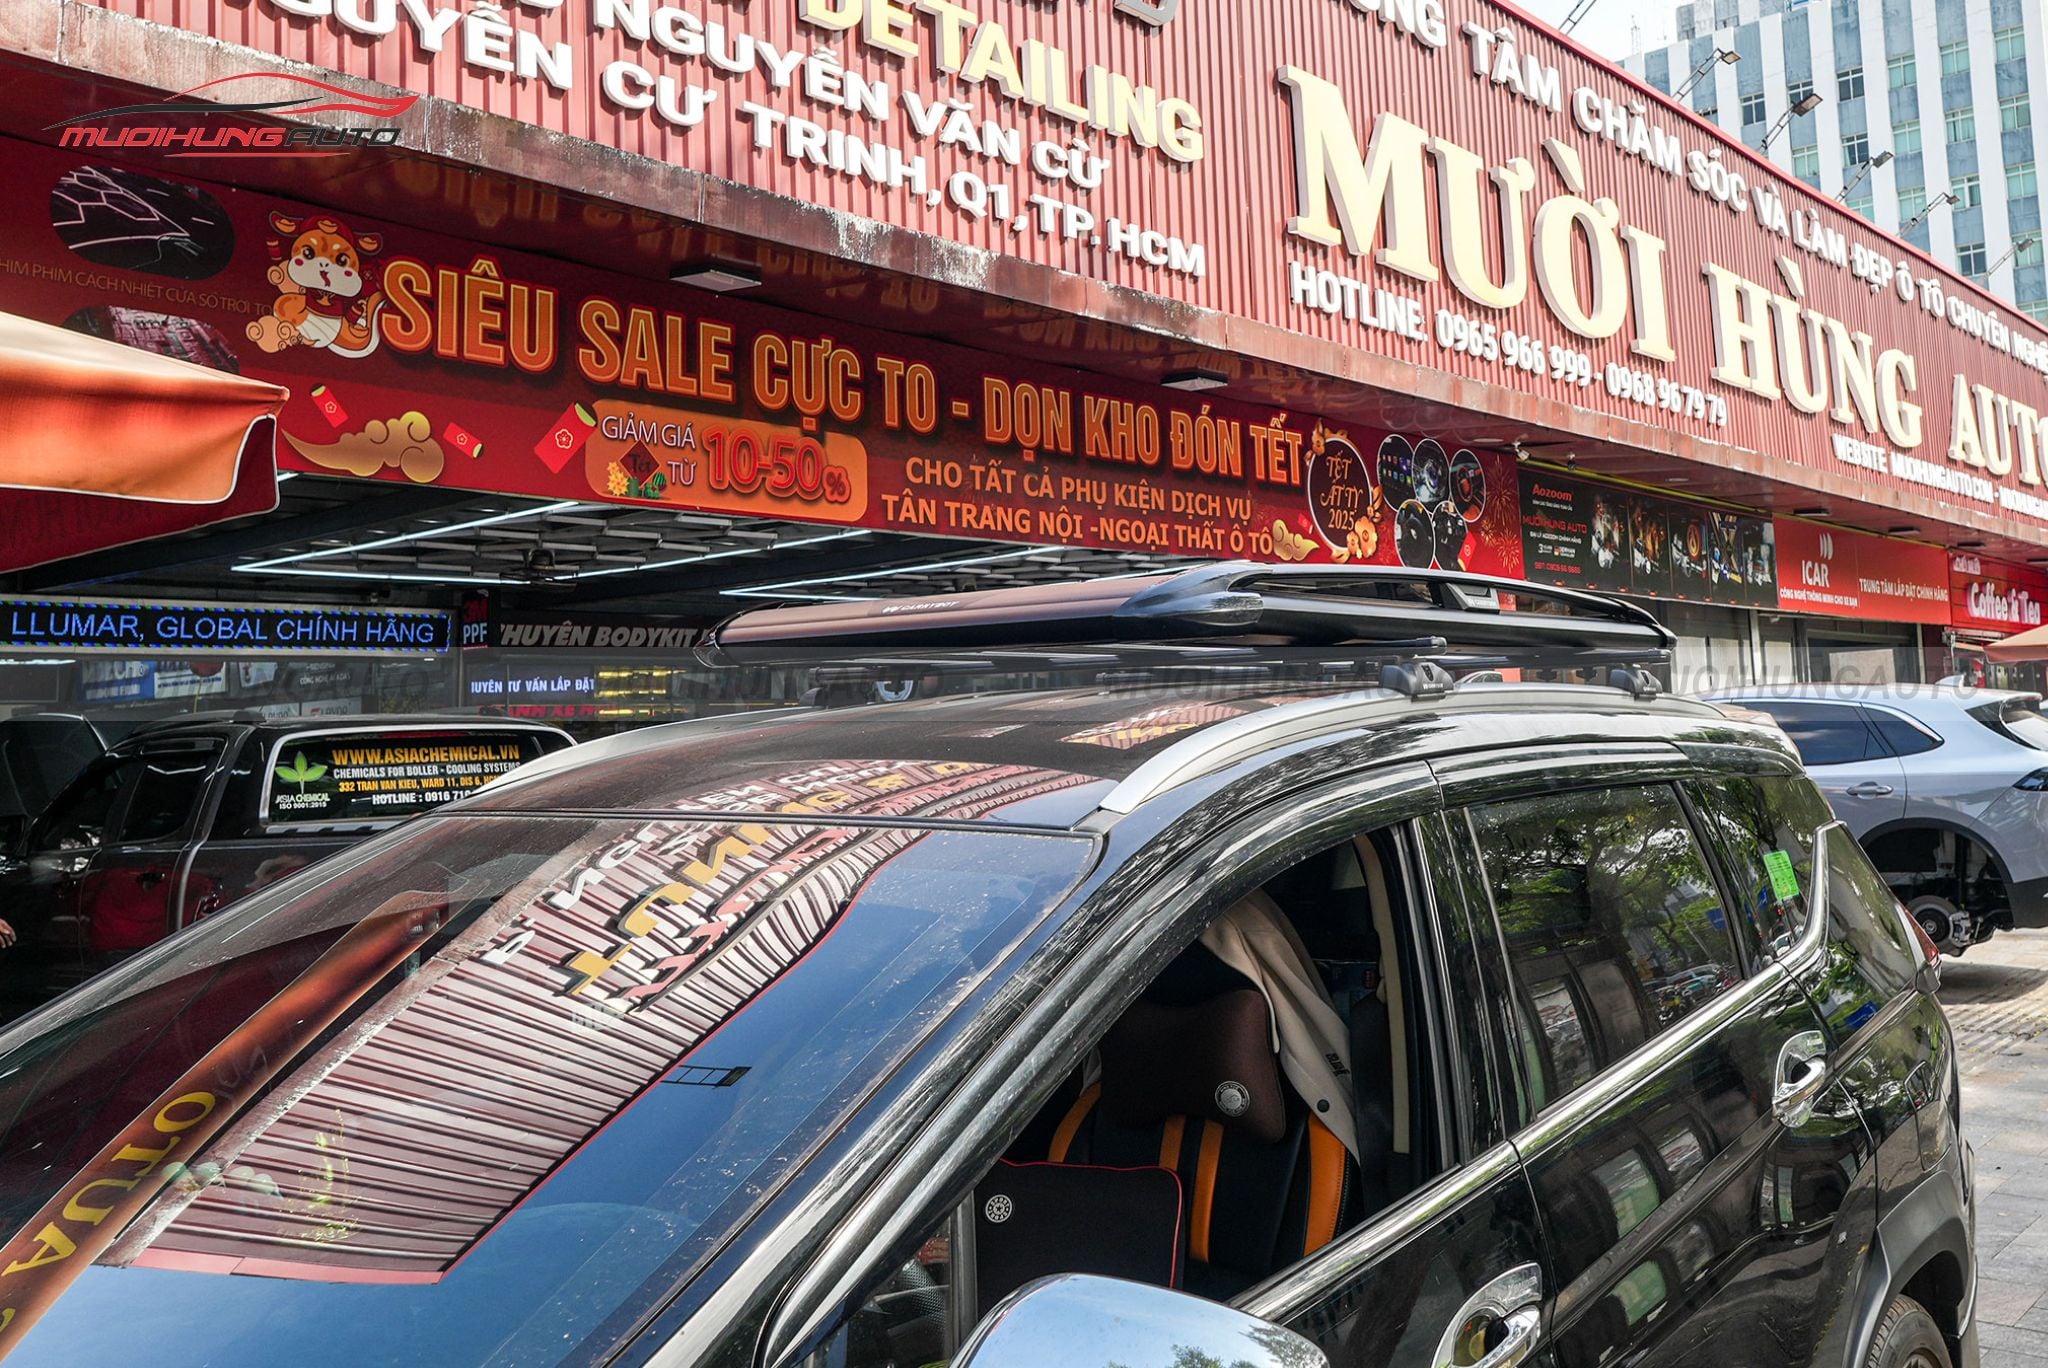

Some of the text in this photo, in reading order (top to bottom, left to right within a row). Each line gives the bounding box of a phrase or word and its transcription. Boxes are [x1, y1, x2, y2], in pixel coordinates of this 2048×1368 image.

[602, 60, 717, 127] CƯ
[902, 89, 1021, 165] VĂN
[1032, 138, 1110, 189] CỪ
[1462, 20, 1562, 113] TÂM
[1572, 86, 1683, 177] CHĂM
[1687, 149, 1748, 214] SÓC
[1751, 182, 1790, 239] VÀ
[1791, 207, 1848, 268] LÀM
[1850, 242, 1894, 294] ĐẸP
[1896, 261, 1915, 302] Ô
[1916, 278, 1946, 318] TÔ
[1946, 295, 2011, 353] CHUYÊN
[1278, 65, 1676, 364] MƯỜI
[1702, 255, 1923, 449] HÙNG
[32, 263, 73, 283] PHIM
[381, 258, 556, 372] SIÊU
[578, 299, 735, 403] SALE
[752, 332, 863, 431] CỰC
[876, 356, 937, 435] TO
[952, 402, 969, 419] -
[983, 375, 1073, 463] DỌN
[1084, 395, 1161, 467] KHO
[1170, 404, 1242, 480] ĐÓN
[1250, 412, 1304, 486] TẾT
[1434, 309, 1498, 361] 0965
[1500, 330, 1546, 375] 966
[1549, 345, 1592, 387] 999
[1605, 362, 1656, 408] 0968
[1656, 377, 1681, 413] 96
[1681, 386, 1707, 420] 79
[1707, 394, 1729, 426] 79
[601, 411, 697, 449] GIẢM GIÁ
[667, 459, 698, 486] TỪ
[1326, 451, 1352, 480] TẾT
[905, 456, 962, 489] CHO
[969, 462, 1016, 494] TẤT
[1022, 465, 1055, 499] CẢ
[1061, 476, 1107, 507] PHỤ
[1114, 479, 1165, 514] KIỆN
[1171, 490, 1222, 521] DỊCH
[1532, 483, 1573, 502] Aozoom
[881, 488, 938, 524] TÂN
[944, 500, 1031, 534] TRANG
[1038, 506, 1083, 541] NỘI
[1175, 517, 1225, 551] THẤT
[1229, 526, 1245, 554] Ô
[1248, 525, 1272, 556] TÔ
[1328, 508, 1355, 531] 2025
[1802, 560, 1830, 588] ICAR
[1859, 578, 1949, 602] TRUNG TÂM LẮP ĐẶT CHÍNH HÃNG
[1967, 582, 2041, 624] Coffee & Tea
[12, 612, 434, 643] LLUMAR, GLOBAL CHÍNH HÃNG
[463, 623, 488, 645] PPF
[500, 620, 593, 646] HUYÊN
[593, 626, 699, 648] BODYKIT
[525, 675, 547, 692] VẤN
[551, 675, 571, 692] LẮP
[332, 745, 520, 766] WWW.ASIACHEMICAL.VN
[333, 767, 386, 779] CHEMICALS
[387, 766, 406, 777] FOR
[406, 765, 439, 776] BOLLER
[446, 763, 482, 775] COOLING
[338, 781, 355, 792] 332
[357, 780, 378, 791] TRAN
[379, 780, 397, 790] VAN
[398, 778, 420, 791] KIEU,
[421, 777, 445, 788] WARD
[460, 776, 474, 786] DIS
[372, 793, 417, 806] HOTLINE
[425, 791, 450, 803] 0916
